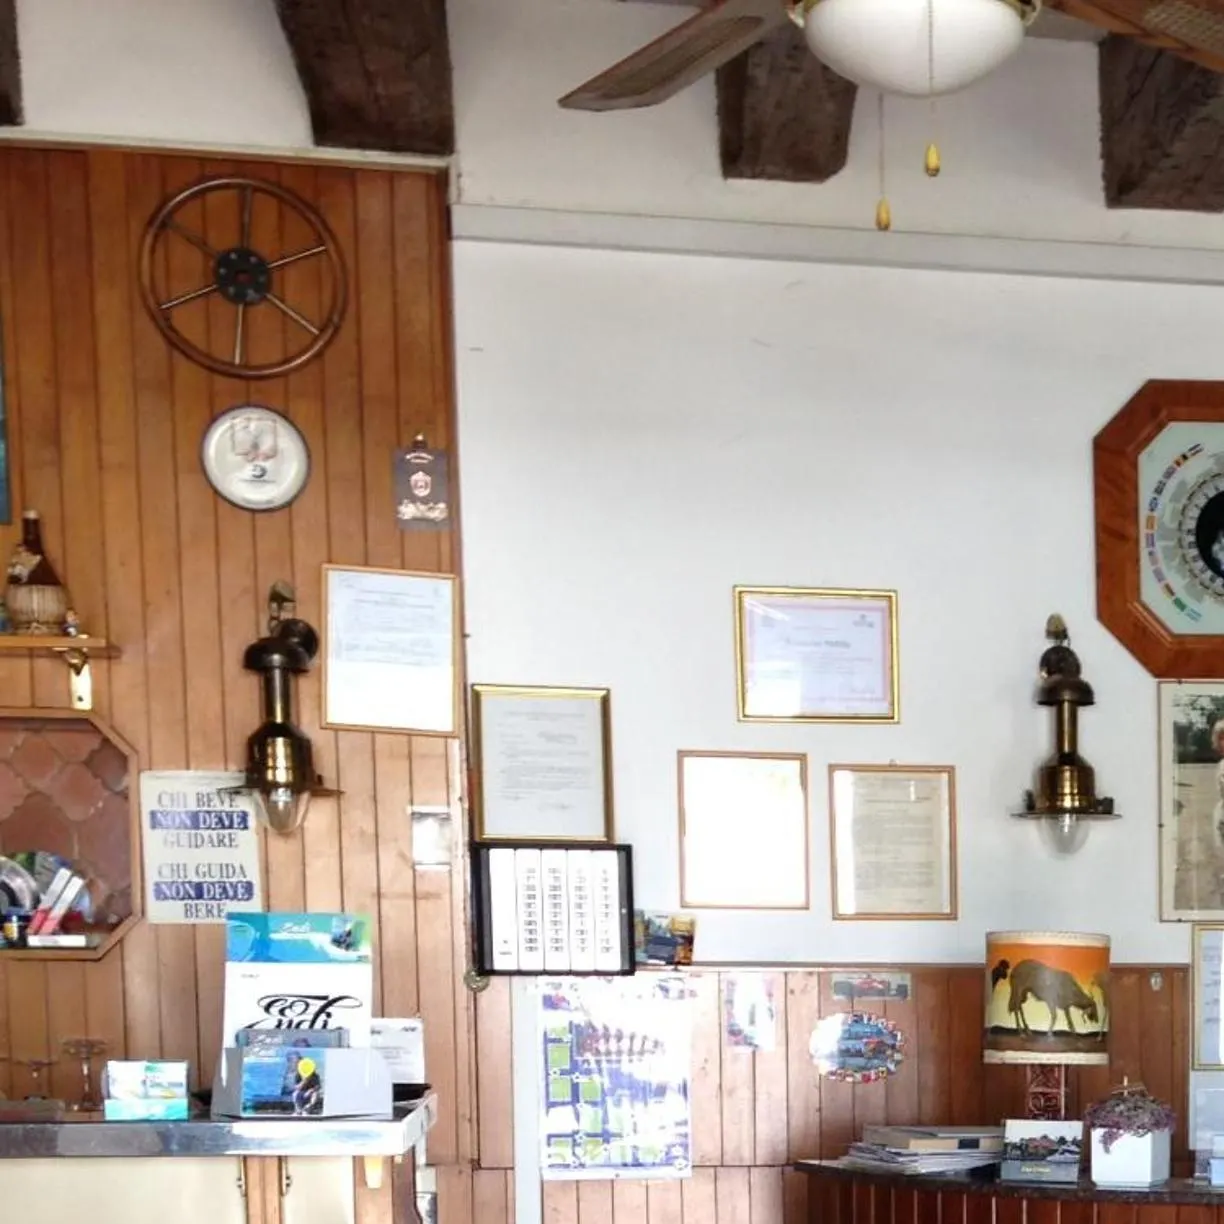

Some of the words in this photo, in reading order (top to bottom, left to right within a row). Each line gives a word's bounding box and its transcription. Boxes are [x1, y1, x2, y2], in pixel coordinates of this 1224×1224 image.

[157, 791, 187, 808] CHI
[196, 790, 240, 808] BEVE
[156, 811, 192, 828] NON
[200, 811, 244, 828] DEVE
[164, 832, 239, 848] GUIDARE
[158, 863, 187, 879] CHI
[195, 863, 247, 879] GUIDA
[160, 882, 196, 899] NON
[203, 882, 249, 899] DEVE
[184, 902, 227, 919] BERE
